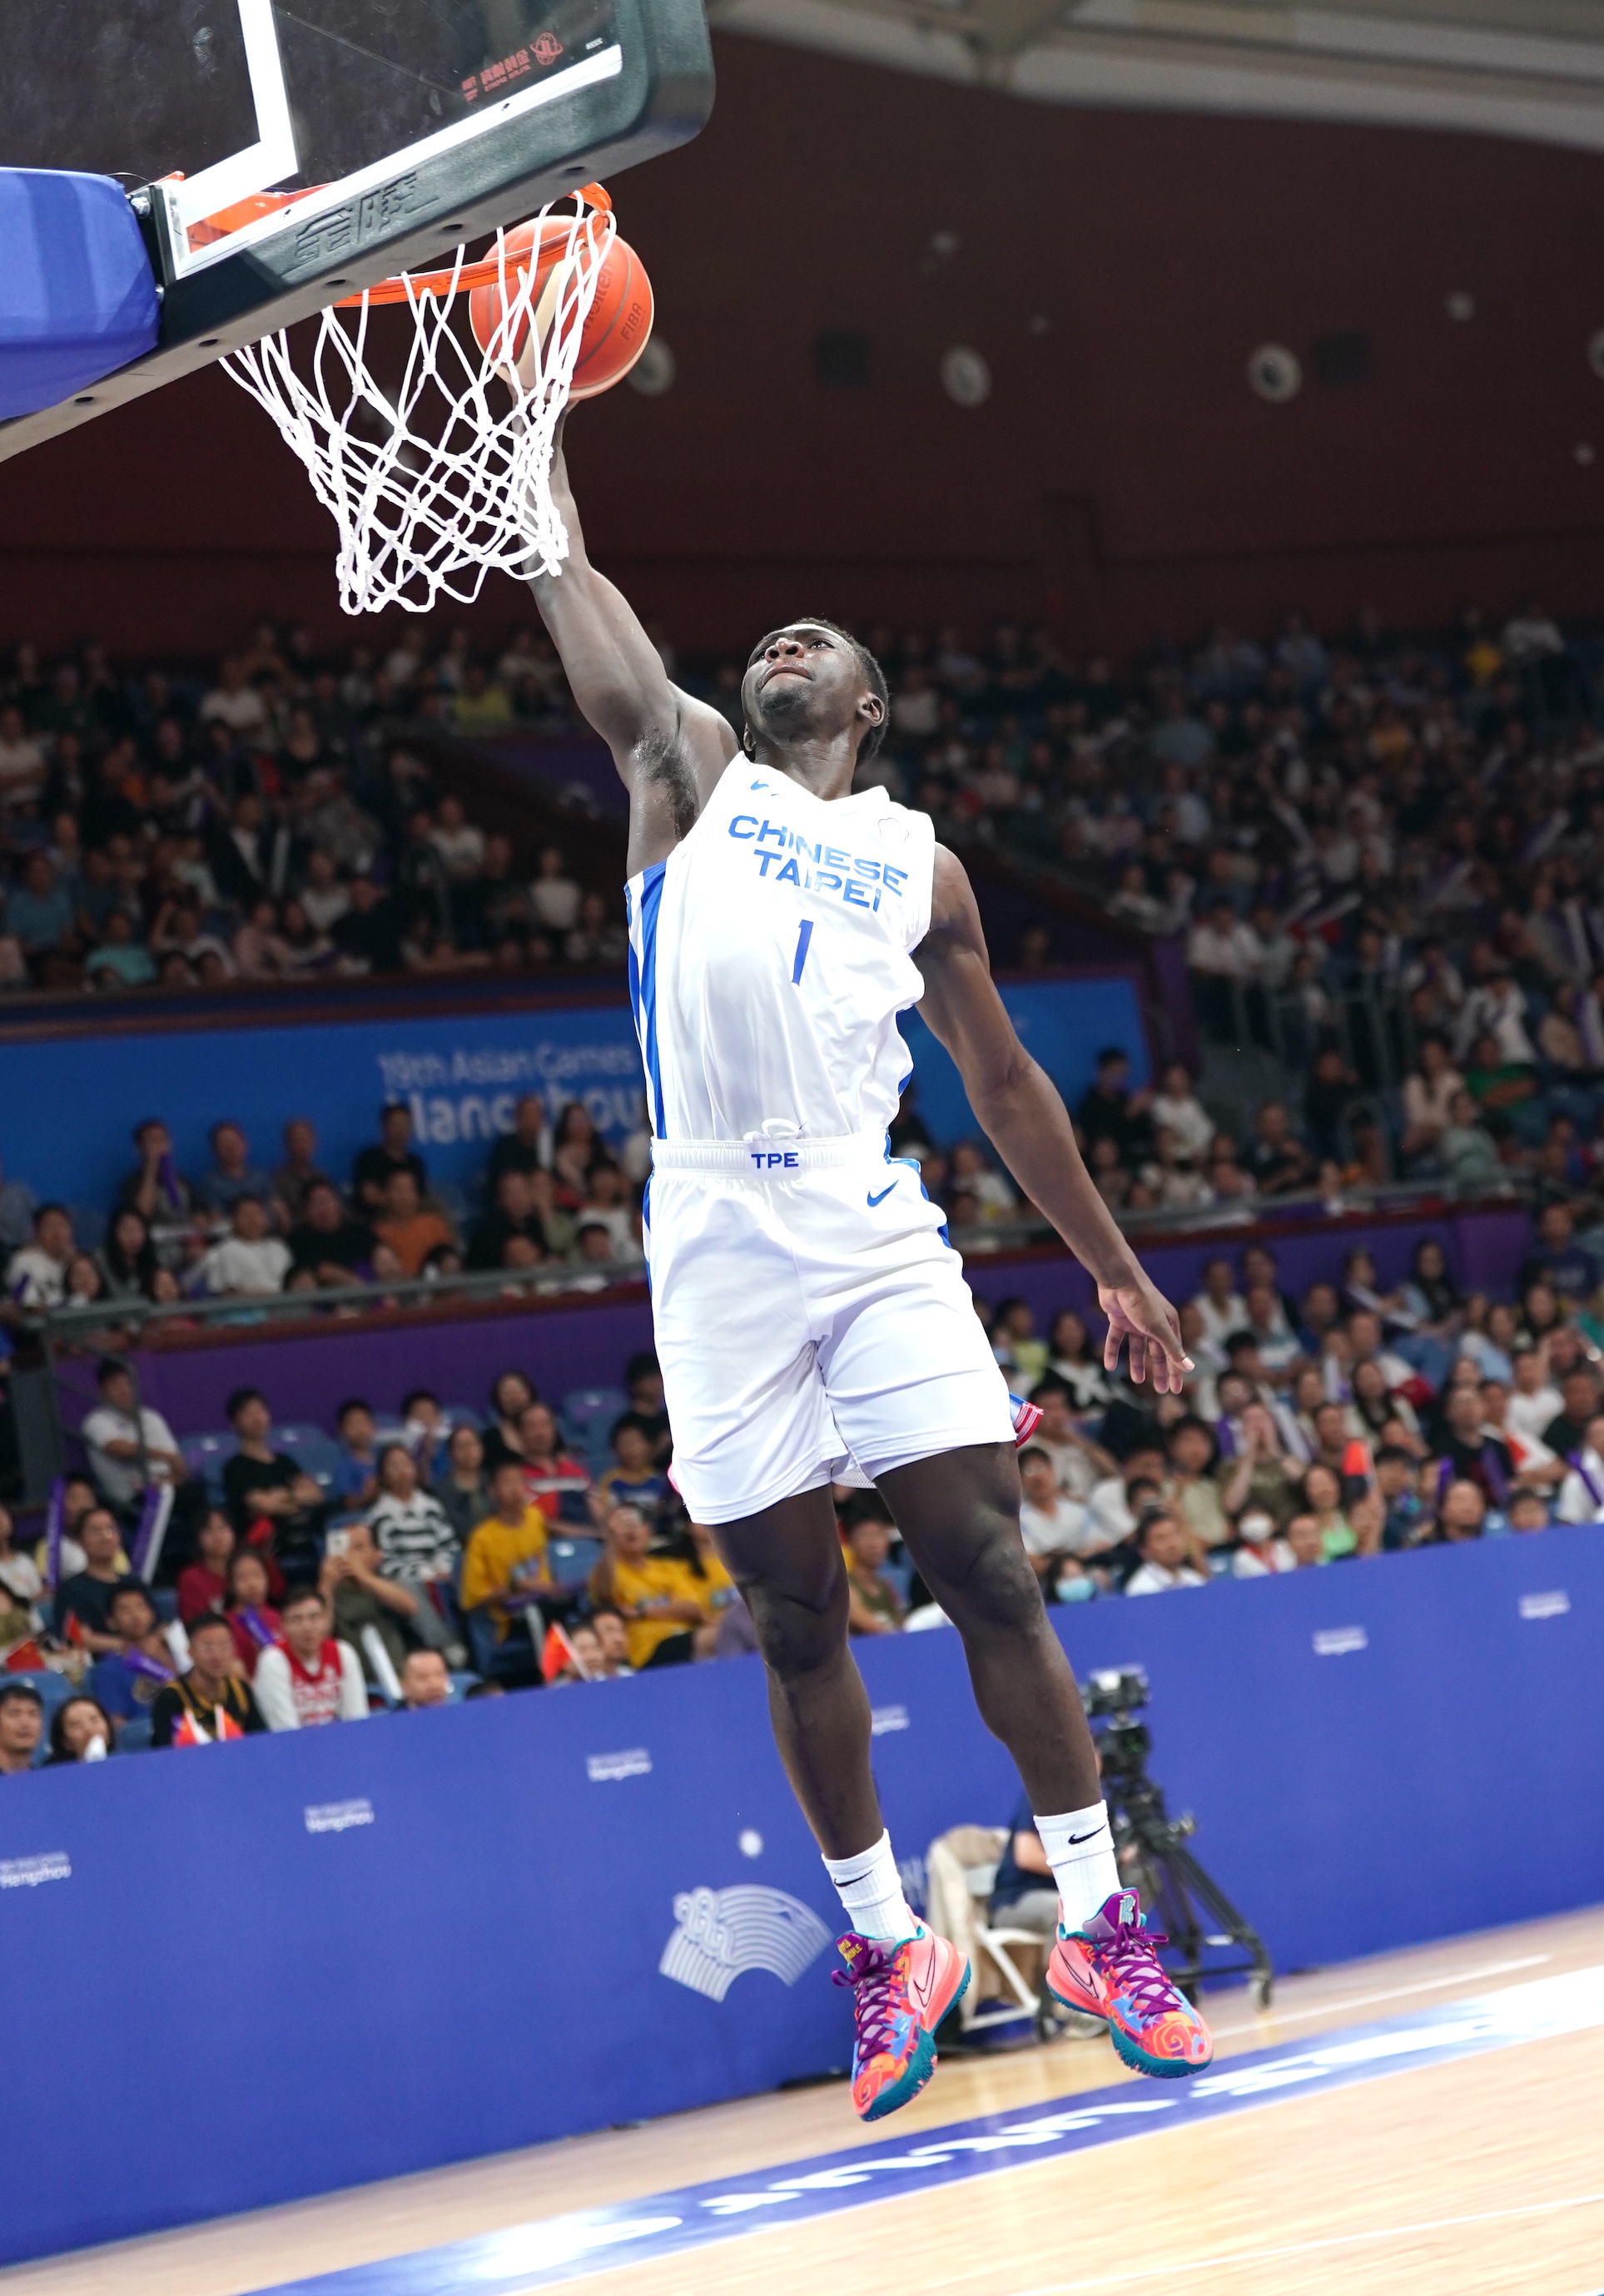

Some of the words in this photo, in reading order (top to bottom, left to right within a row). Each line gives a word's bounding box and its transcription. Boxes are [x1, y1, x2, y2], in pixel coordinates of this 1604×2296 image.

[620, 302, 643, 341] FIBA
[728, 815, 908, 897] CHINESE
[754, 849, 881, 913] TAIPEI
[791, 919, 814, 986] 1
[453, 1049, 531, 1084] Asian
[535, 1042, 638, 1081] Games
[751, 1153, 799, 1168] TPE
